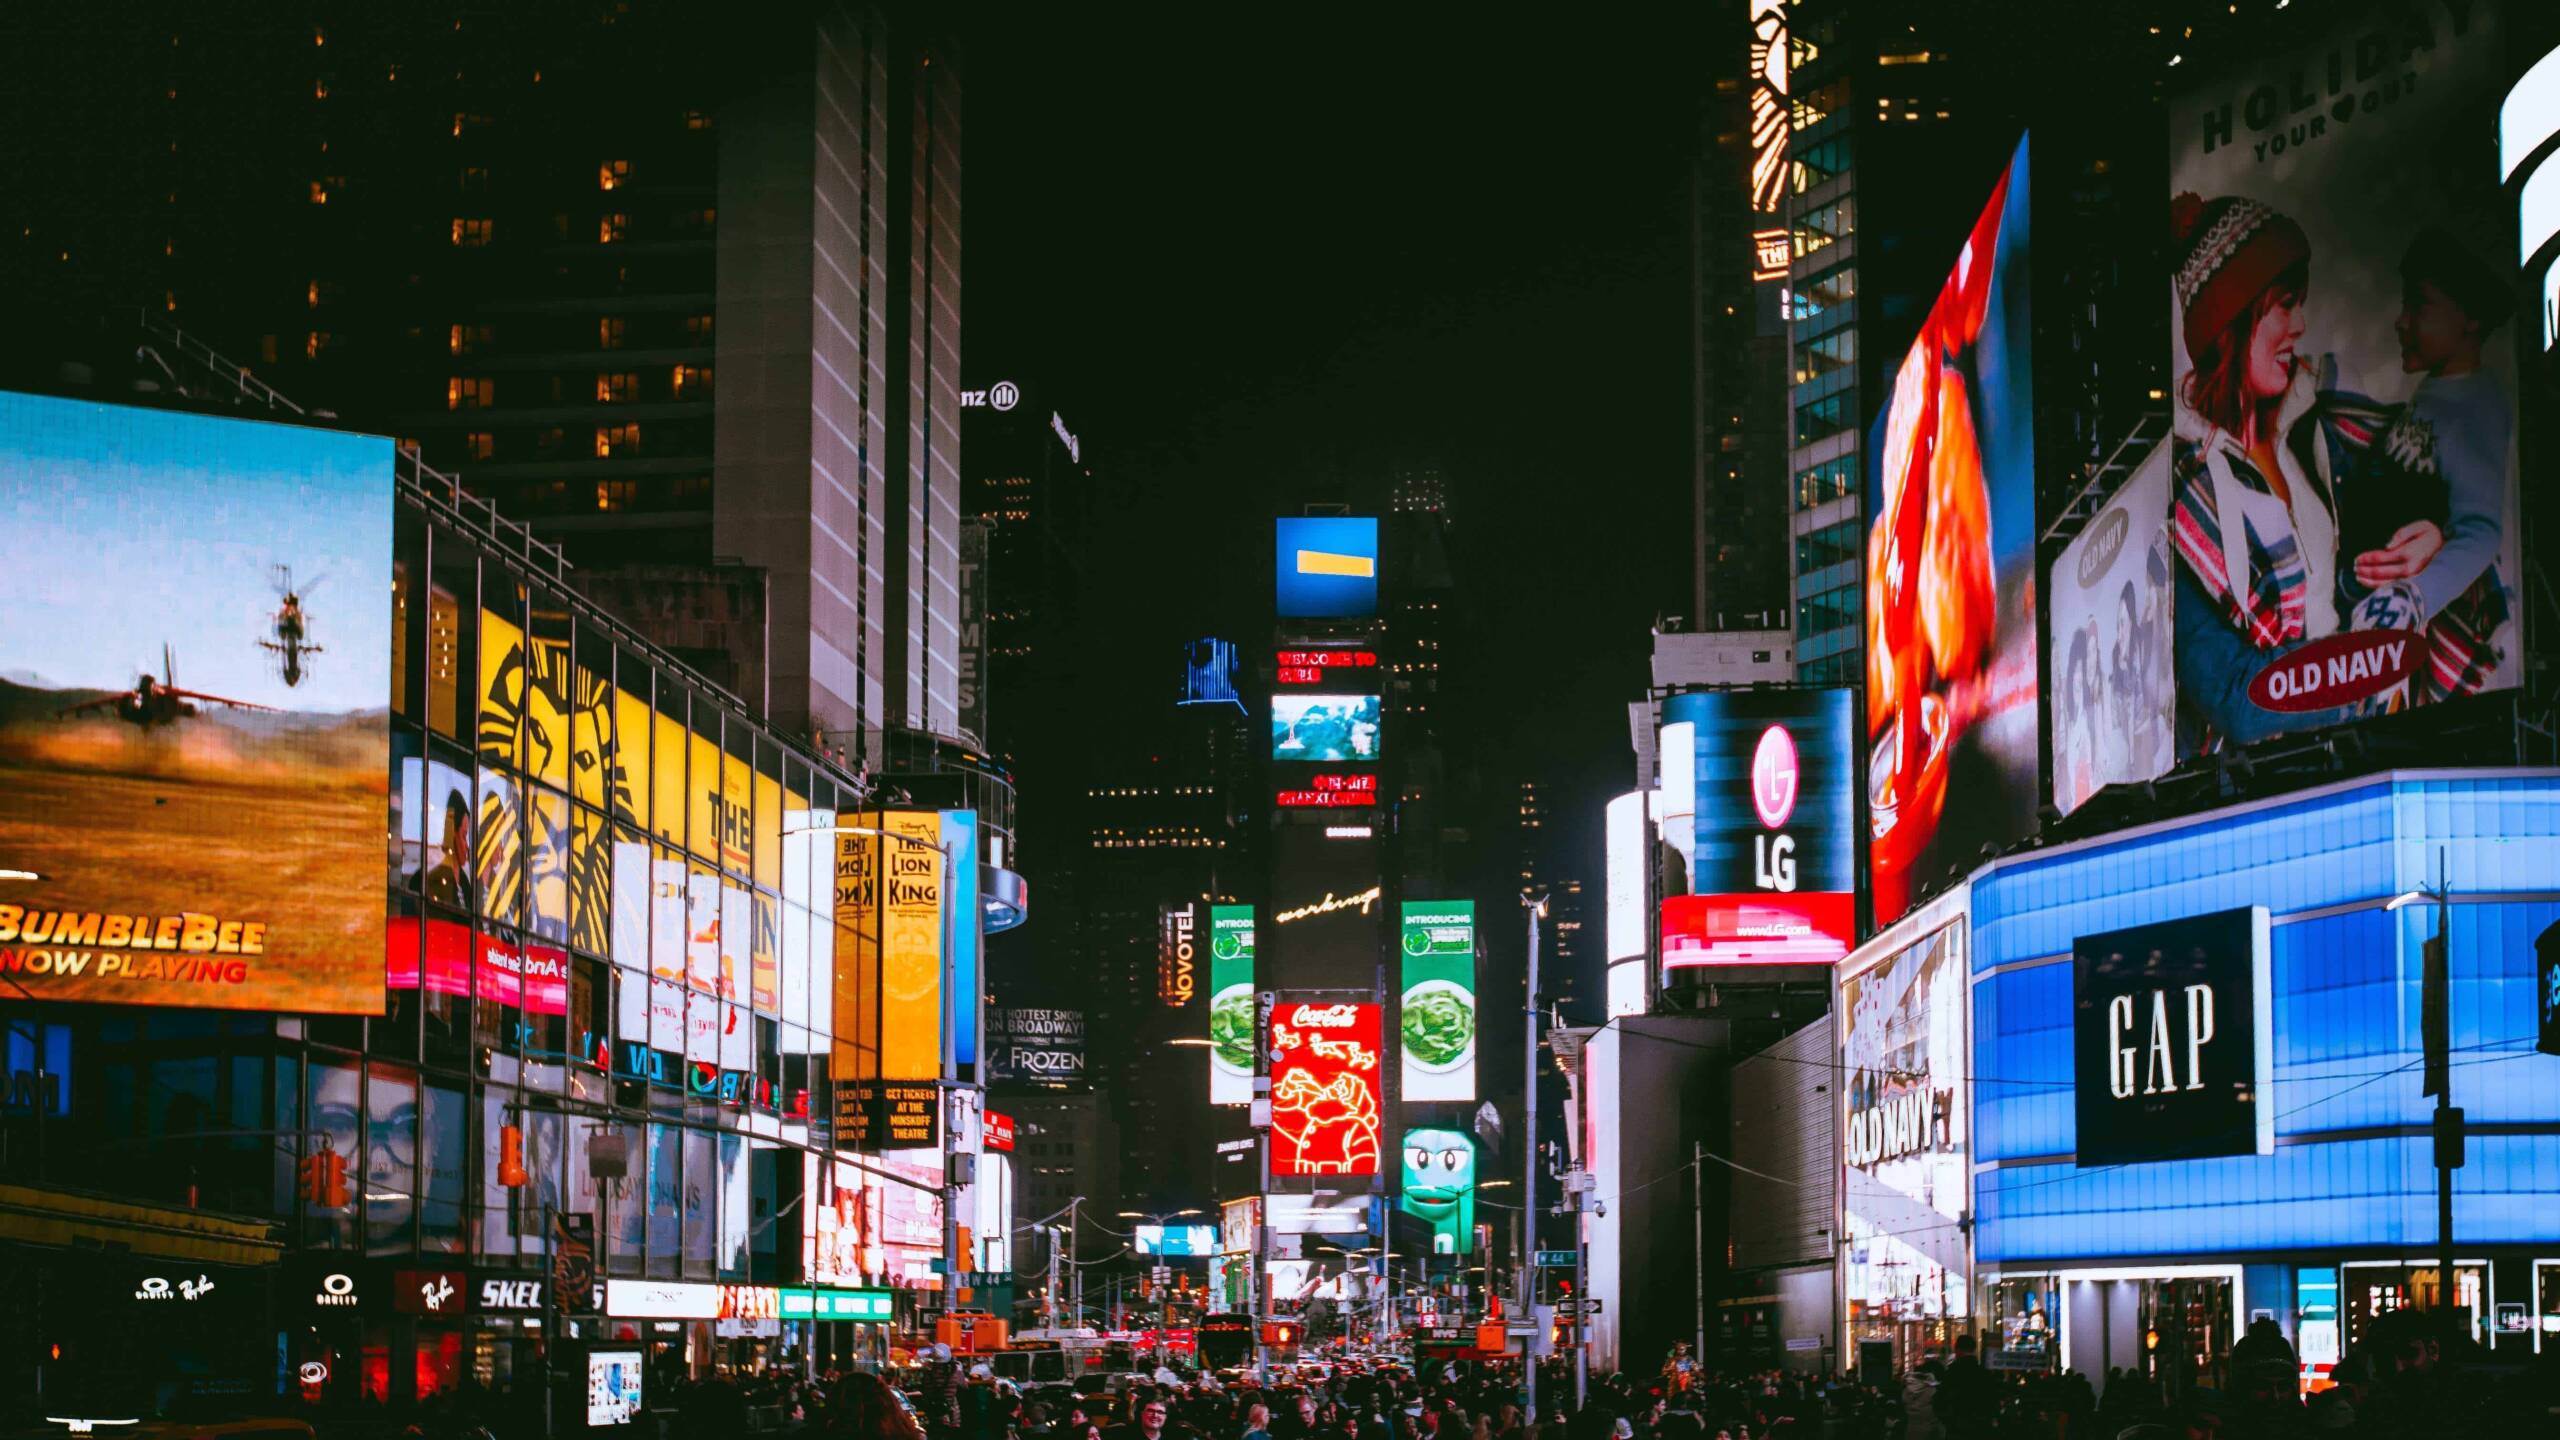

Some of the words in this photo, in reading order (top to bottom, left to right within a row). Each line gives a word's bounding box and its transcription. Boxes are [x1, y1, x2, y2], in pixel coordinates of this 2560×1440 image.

[2203, 0, 2472, 154] HOLIDAY
[2254, 115, 2327, 163] YOUR
[2361, 72, 2418, 114] OUT
[959, 563, 979, 709] TIMES
[2267, 662, 2322, 701] OLD
[2328, 640, 2407, 687] NAVY
[708, 790, 750, 853] THE
[897, 837, 925, 851] THE
[1755, 834, 1797, 893] LG
[1405, 914, 1471, 925] INTRODUCING
[1736, 923, 1811, 937] www.LG.com
[0, 950, 91, 977] NOW
[97, 953, 248, 985] PLAYING
[1174, 902, 1194, 1006] NOVOTEL
[1007, 1009, 1051, 1020] HOTTEST
[1054, 1010, 1084, 1021] SNOW
[1008, 1020, 1084, 1034] BROADWAY!
[2108, 983, 2215, 1099] GAP
[1011, 1047, 1085, 1073] FROZEN
[886, 1089, 902, 1100] GET
[903, 1089, 936, 1100] TICKETS
[896, 1102, 908, 1113] AT
[909, 1102, 925, 1113] THE
[893, 1127, 929, 1140] THEATRE
[1849, 1106, 1883, 1167] OLD
[1884, 1086, 1935, 1158] NAVY
